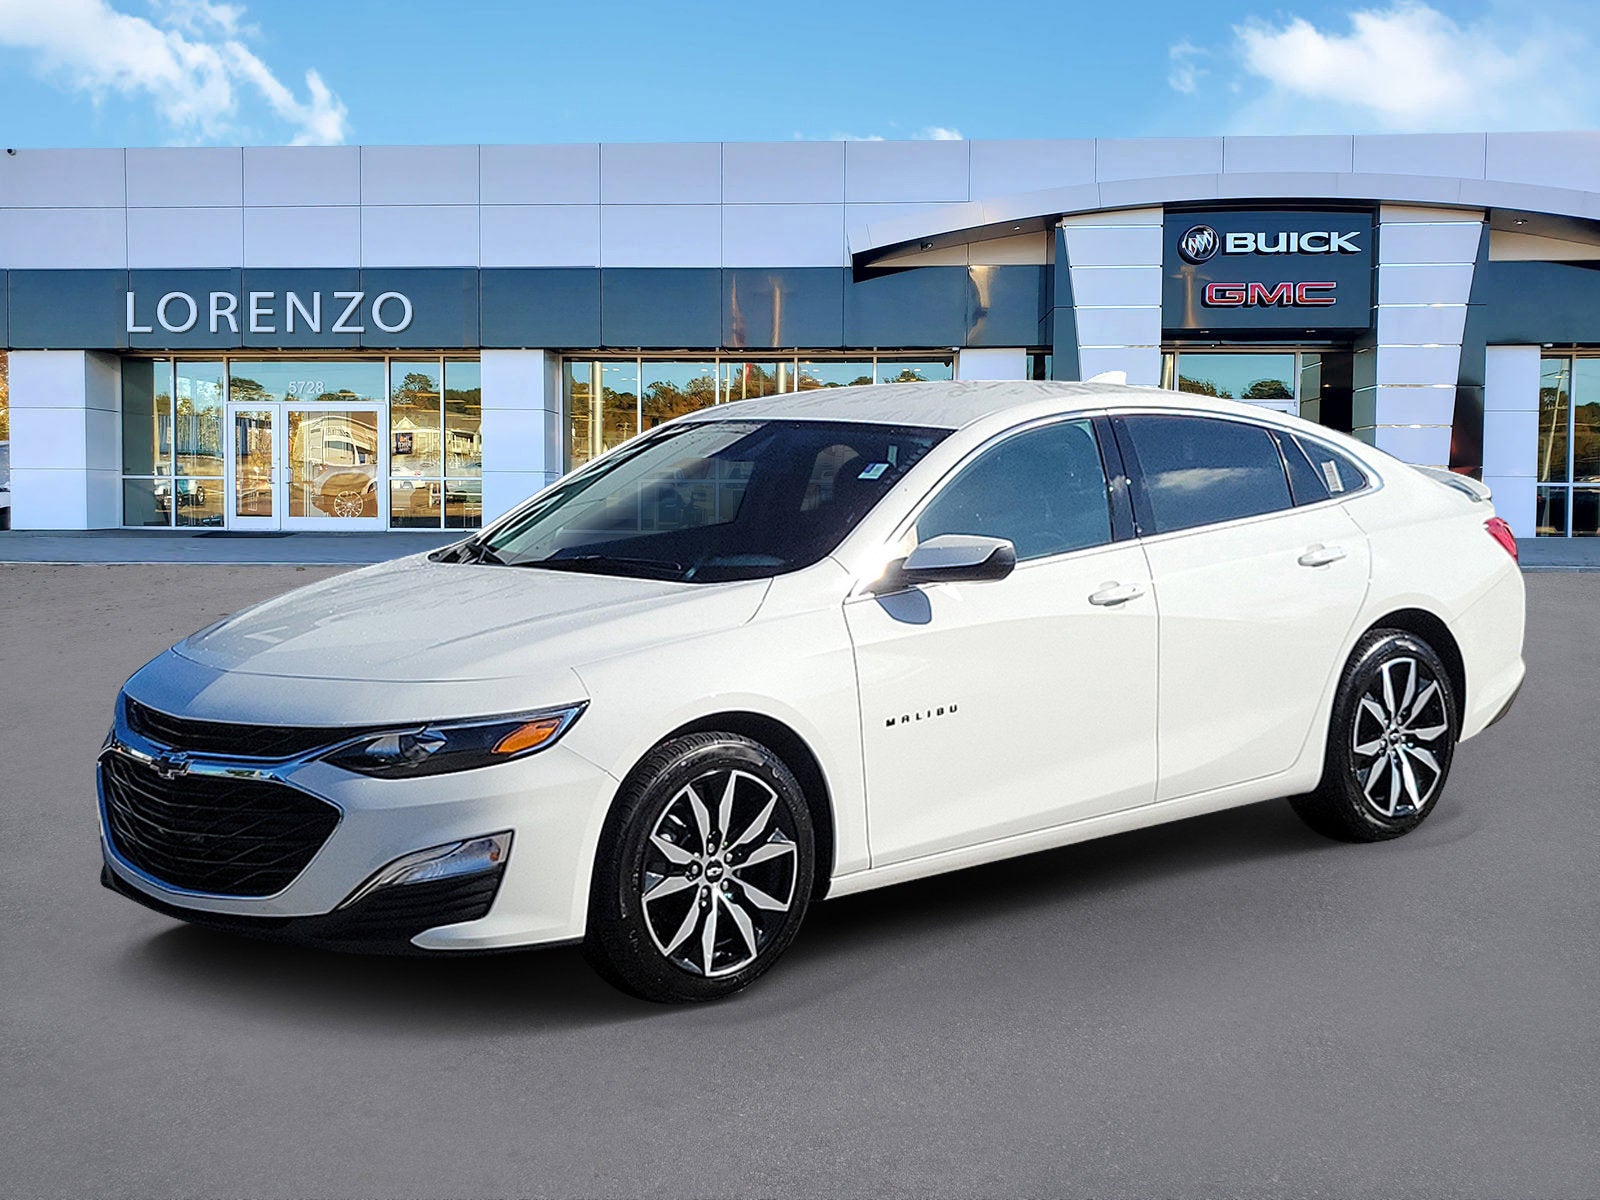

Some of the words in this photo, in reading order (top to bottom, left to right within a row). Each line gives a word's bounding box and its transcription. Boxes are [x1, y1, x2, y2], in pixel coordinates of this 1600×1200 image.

[1225, 231, 1362, 253] BUICK
[1206, 282, 1337, 305] GMC
[126, 291, 413, 333] LORENZO
[288, 380, 325, 394] 5728
[886, 704, 958, 727] MALIBU
